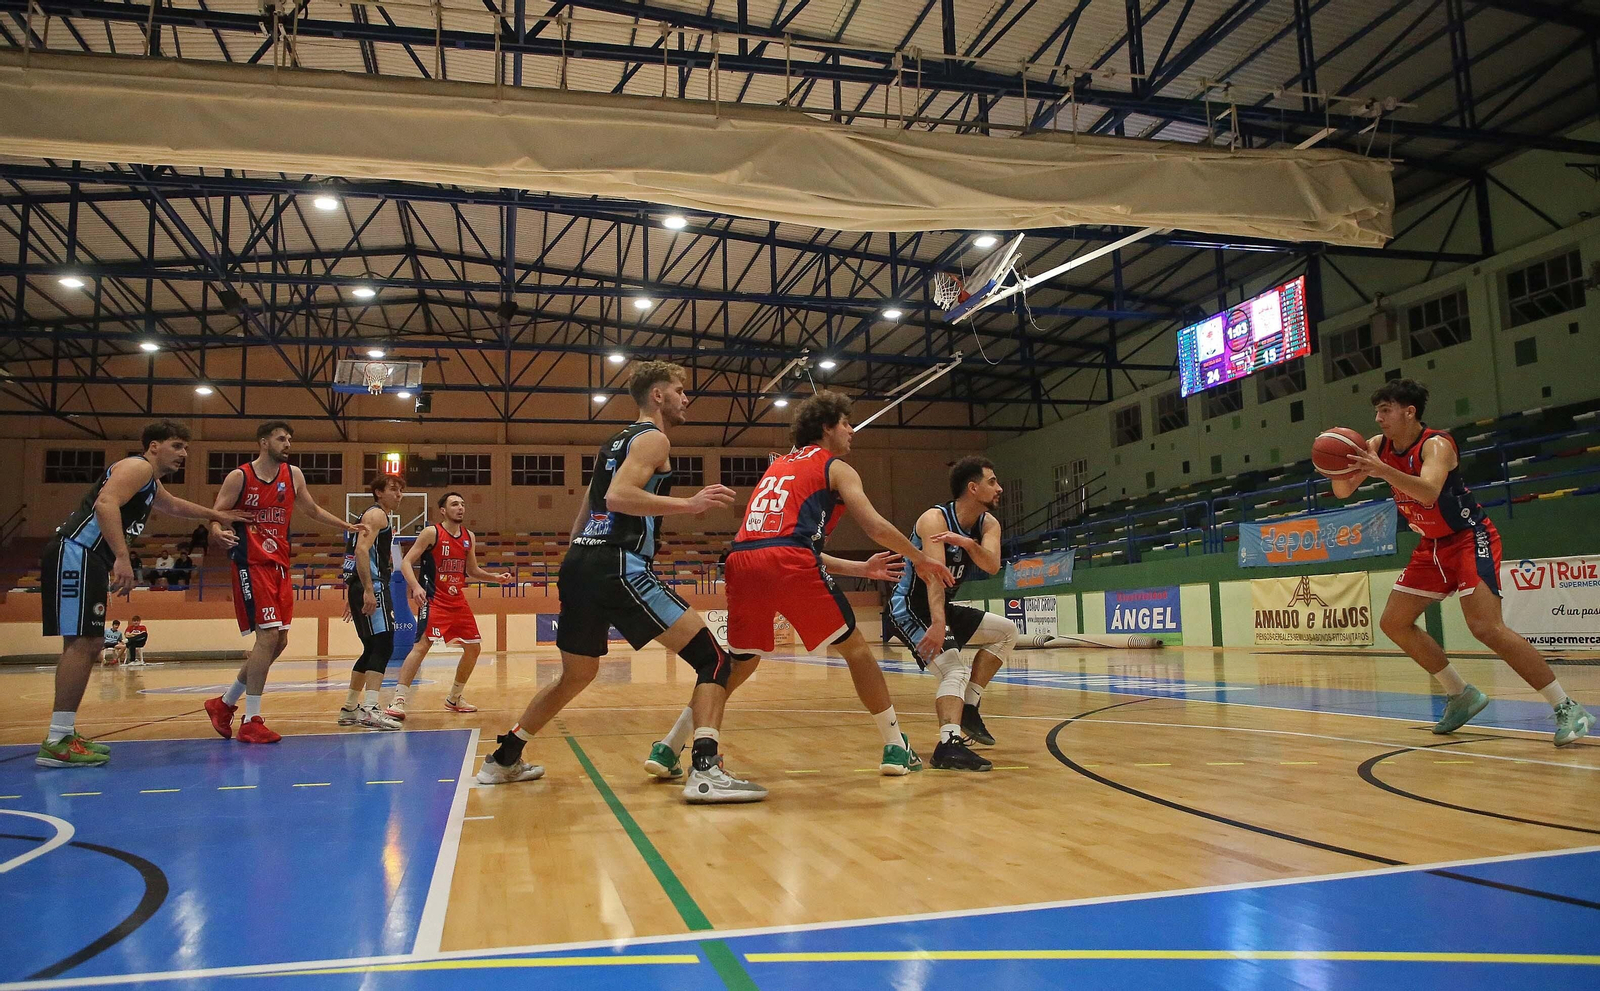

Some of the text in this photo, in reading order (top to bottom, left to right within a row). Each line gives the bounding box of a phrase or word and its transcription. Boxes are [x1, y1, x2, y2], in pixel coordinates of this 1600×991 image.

[1262, 347, 1277, 363] 15
[1206, 368, 1220, 384] 24
[386, 460, 399, 473] 10
[245, 493, 260, 507] 22
[750, 475, 796, 512] 25
[1260, 522, 1363, 560] deportes
[441, 545, 450, 556] 16
[1557, 560, 1598, 580] Ruiz
[62, 570, 80, 598] ULB
[262, 607, 276, 621] 22
[1110, 604, 1177, 630] ÁNGEL
[1255, 606, 1369, 629] AMADO e HIJOS
[1551, 604, 1565, 616] A
[1566, 607, 1581, 616] un
[431, 626, 441, 637] 16
